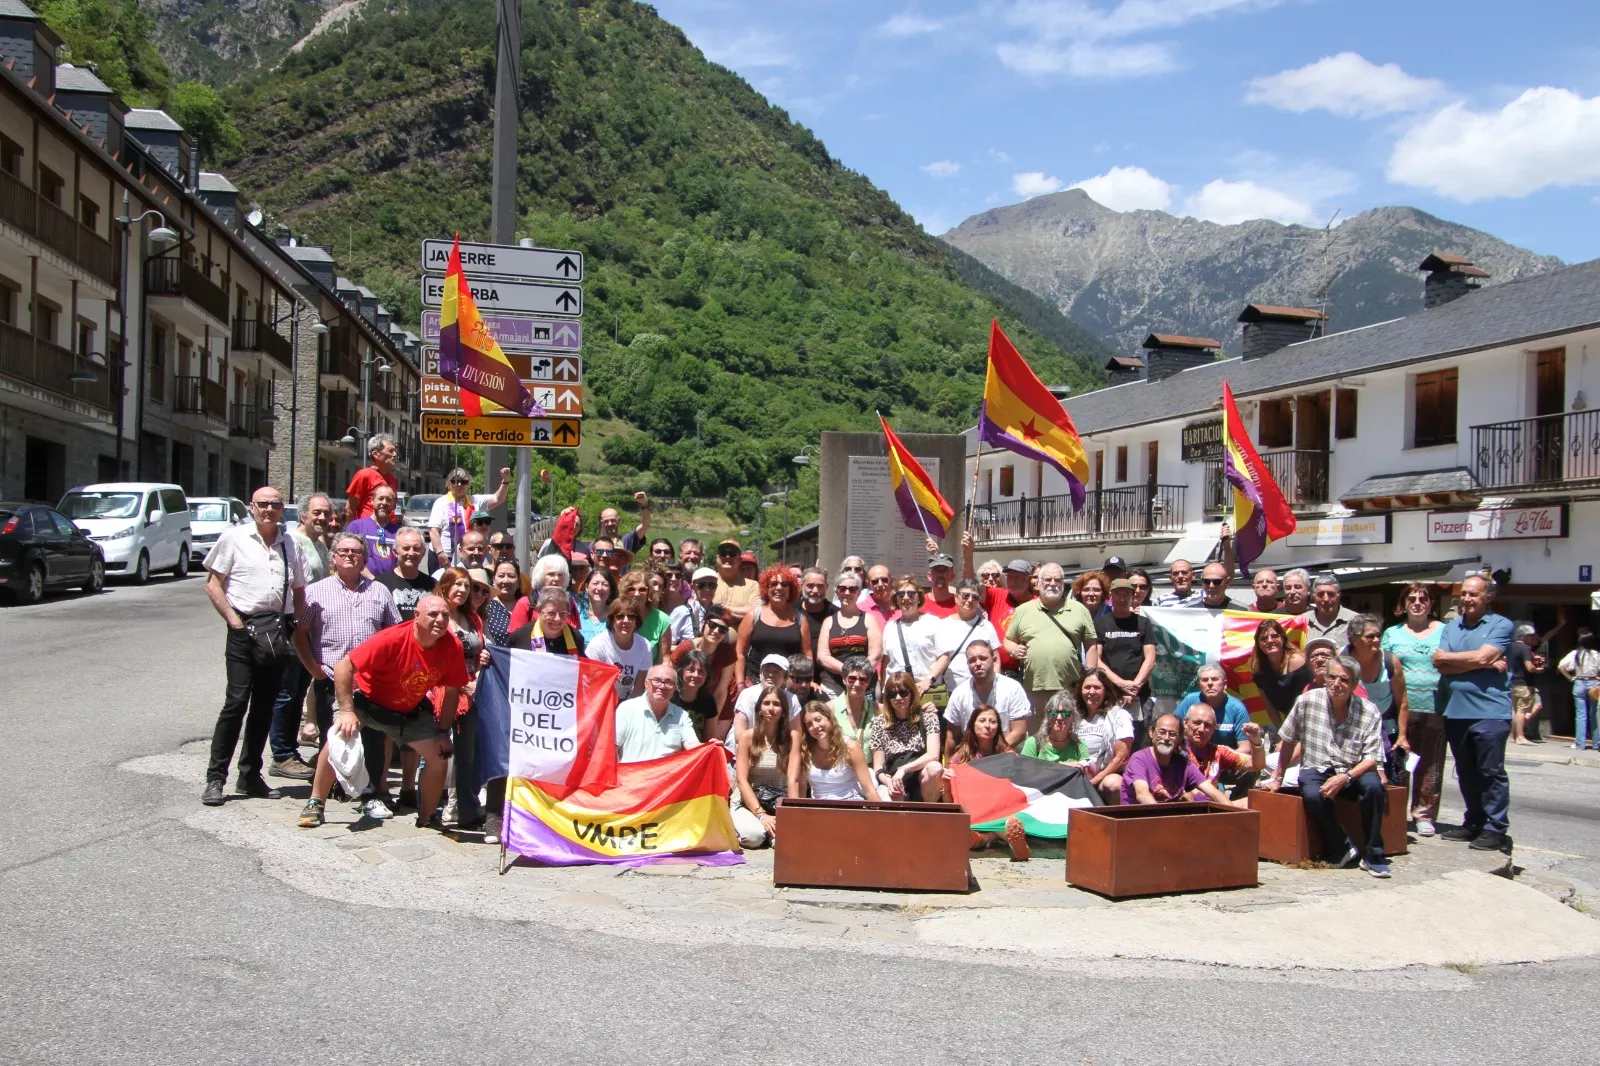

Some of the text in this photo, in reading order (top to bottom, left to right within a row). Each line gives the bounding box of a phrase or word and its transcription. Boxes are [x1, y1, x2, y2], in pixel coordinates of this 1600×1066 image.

[429, 250, 496, 266] JAVERRE
[428, 285, 499, 301] ESRBA
[462, 364, 505, 391] DIVISIÓN
[424, 382, 450, 392] pista
[424, 395, 438, 404] 14
[427, 417, 468, 427] parador
[427, 427, 524, 441] Monte Perdido
[1183, 425, 1224, 446] HABITACION
[1514, 512, 1528, 534] La
[1529, 510, 1553, 532] Vita
[510, 688, 575, 711] HIJ@S
[522, 712, 562, 731] DEL
[511, 728, 575, 753] EXILIO
